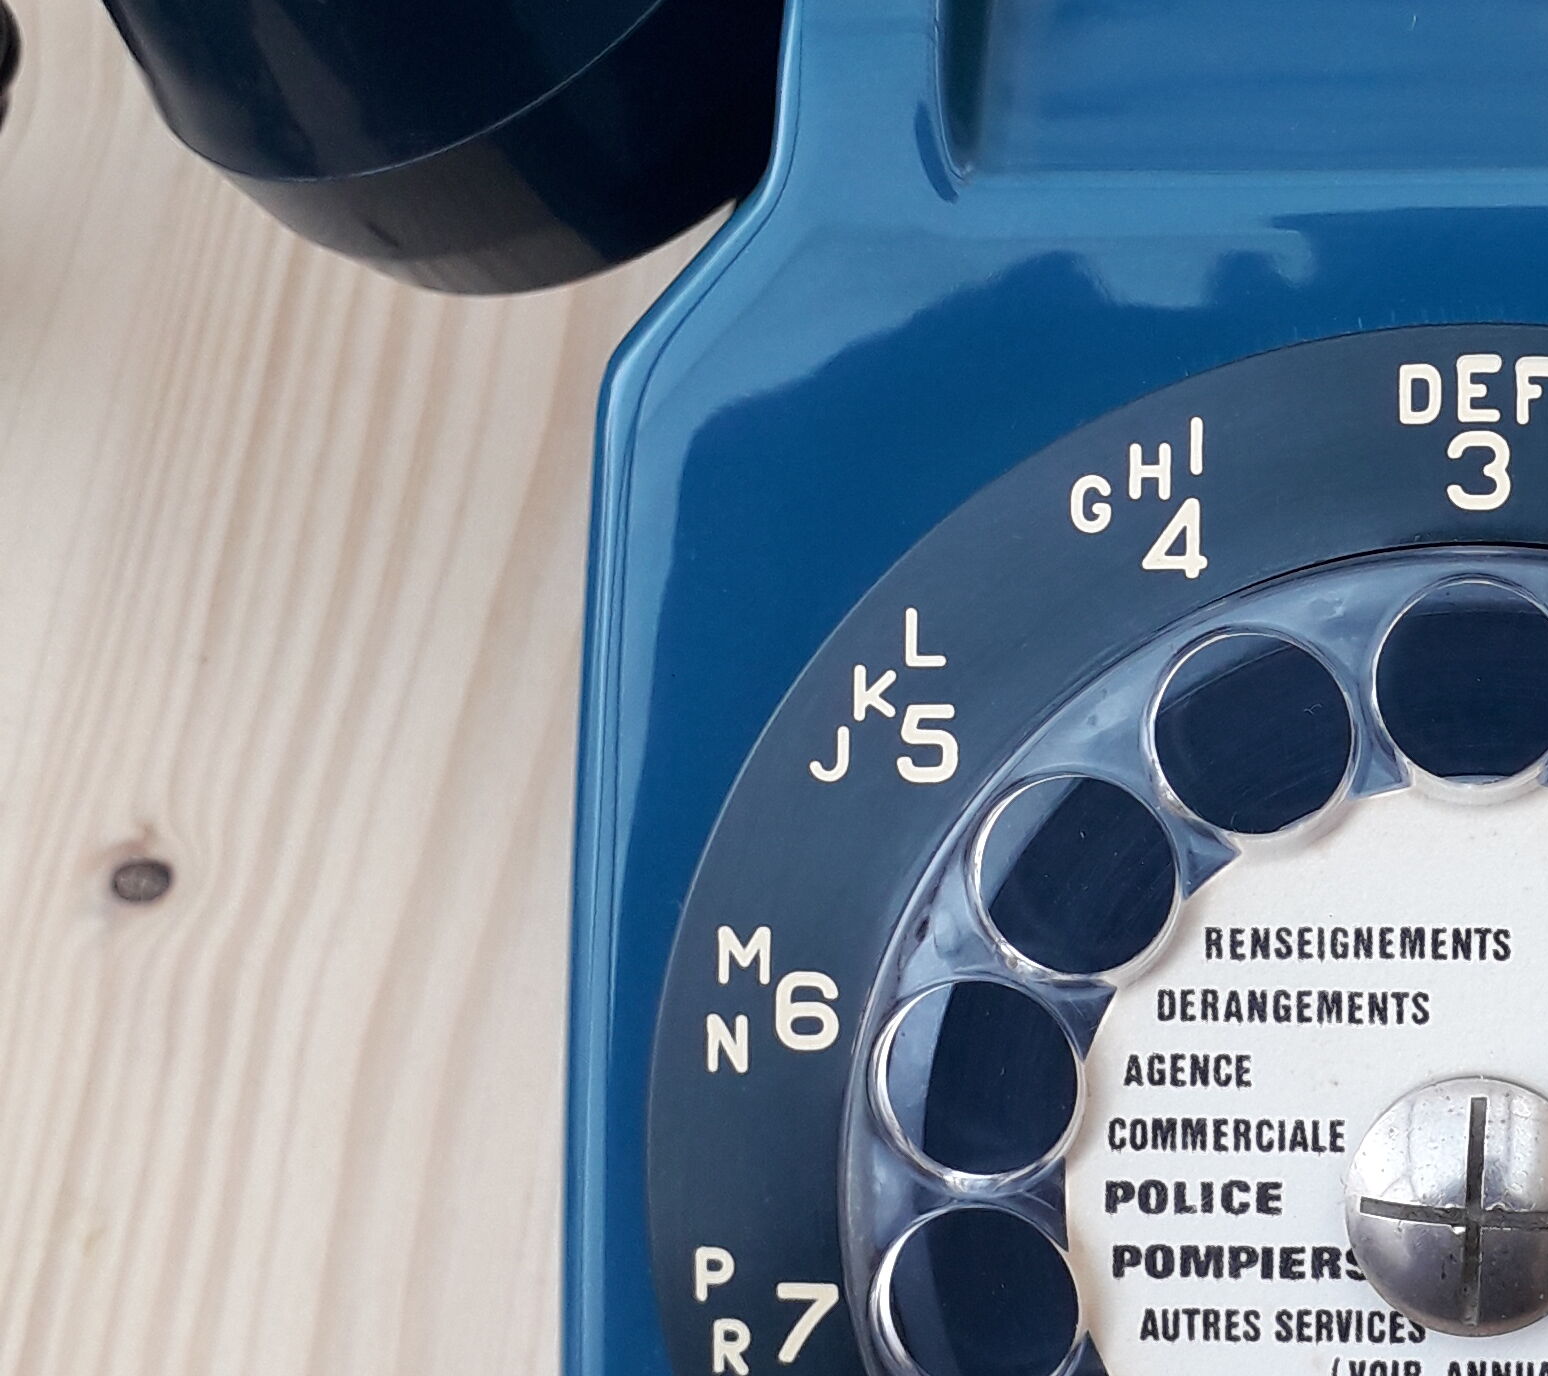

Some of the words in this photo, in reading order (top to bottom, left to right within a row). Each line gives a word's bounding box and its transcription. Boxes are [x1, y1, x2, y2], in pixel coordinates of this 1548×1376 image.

[1069, 415, 1206, 535] GHI
[1445, 429, 1513, 512] 3
[1140, 496, 1210, 580] 4
[895, 702, 960, 785] 5
[1204, 925, 1512, 962] RENSEIGNEMENTS
[774, 969, 841, 1053] 6
[1156, 988, 1431, 1026] DERANGEMENTS
[1123, 1052, 1254, 1089] AGENCE
[1106, 1116, 1347, 1155] COMMERCIALE
[1104, 1179, 1285, 1216] POLICE
[775, 1281, 841, 1364] 7
[1138, 1307, 1262, 1343] AUTRES
[1274, 1308, 1427, 1345] SERVICES
